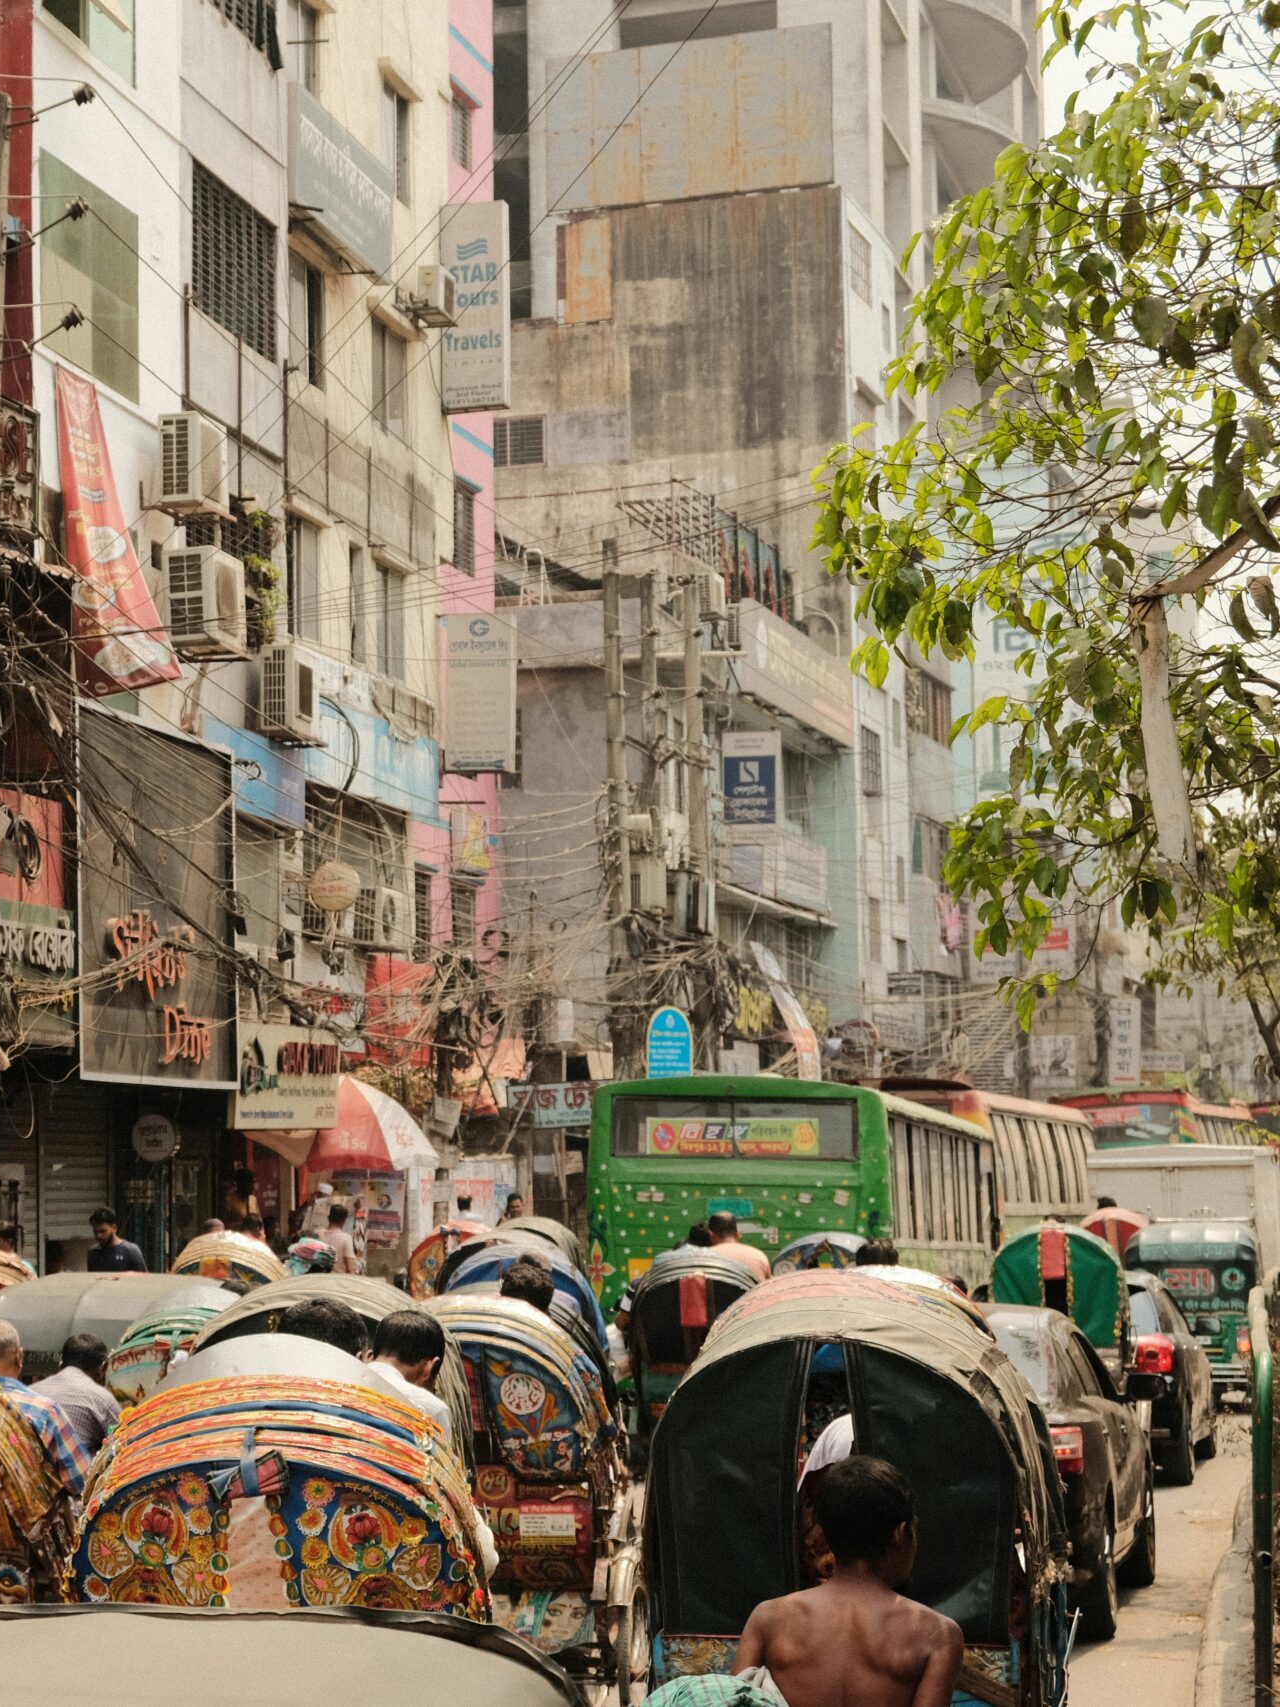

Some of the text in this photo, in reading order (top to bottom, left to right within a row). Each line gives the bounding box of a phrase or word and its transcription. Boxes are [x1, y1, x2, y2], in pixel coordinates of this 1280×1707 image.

[449, 262, 497, 285] STAR
[456, 289, 499, 309] ours
[445, 330, 502, 352] Travels
